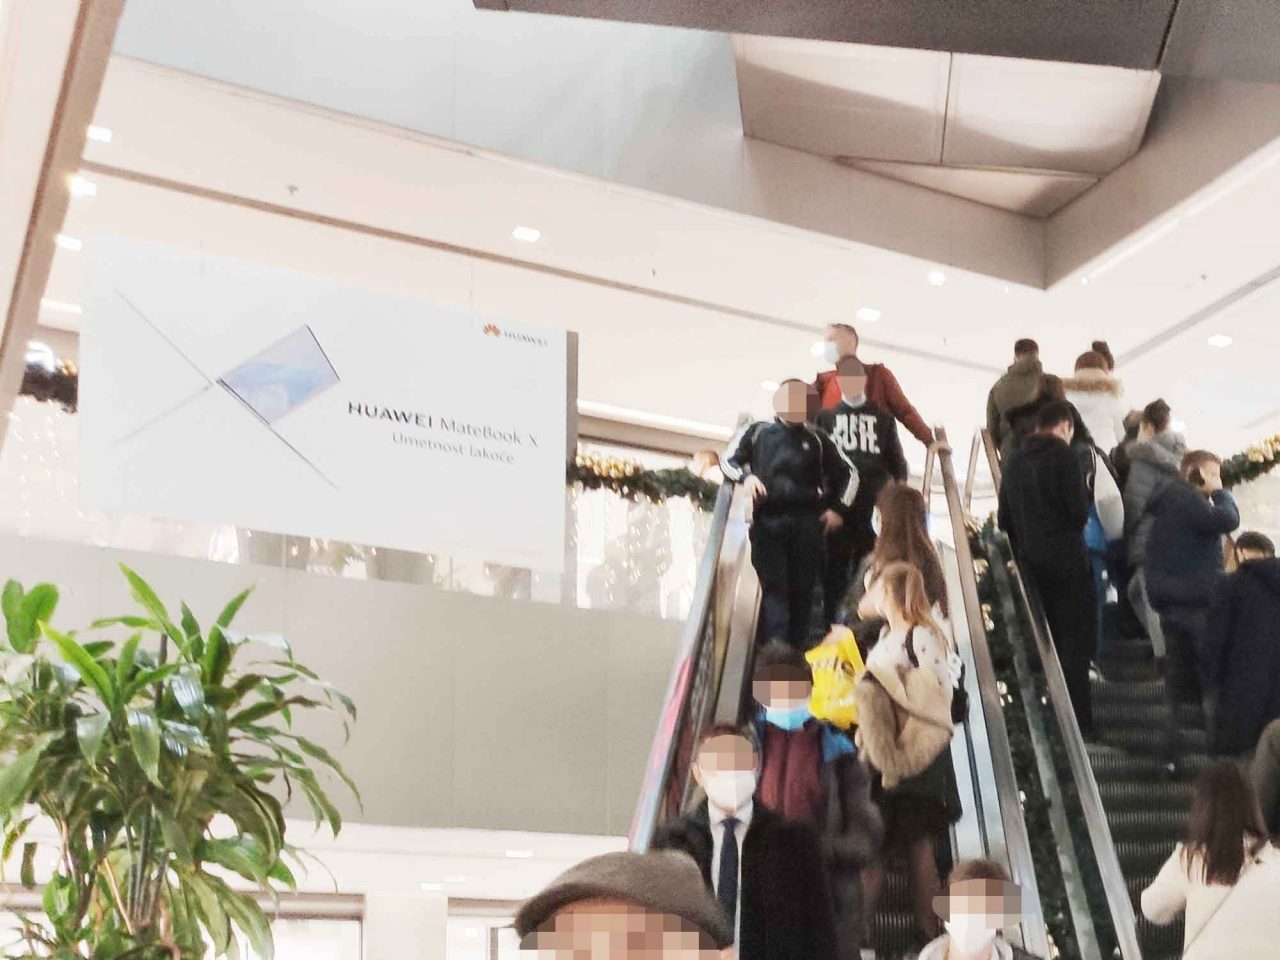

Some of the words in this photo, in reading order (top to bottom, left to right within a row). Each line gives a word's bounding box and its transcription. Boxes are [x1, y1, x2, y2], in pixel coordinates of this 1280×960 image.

[348, 401, 433, 429] HUAWEI
[440, 417, 522, 445] MateBook
[528, 432, 539, 448] X
[392, 431, 464, 455] Umetnost
